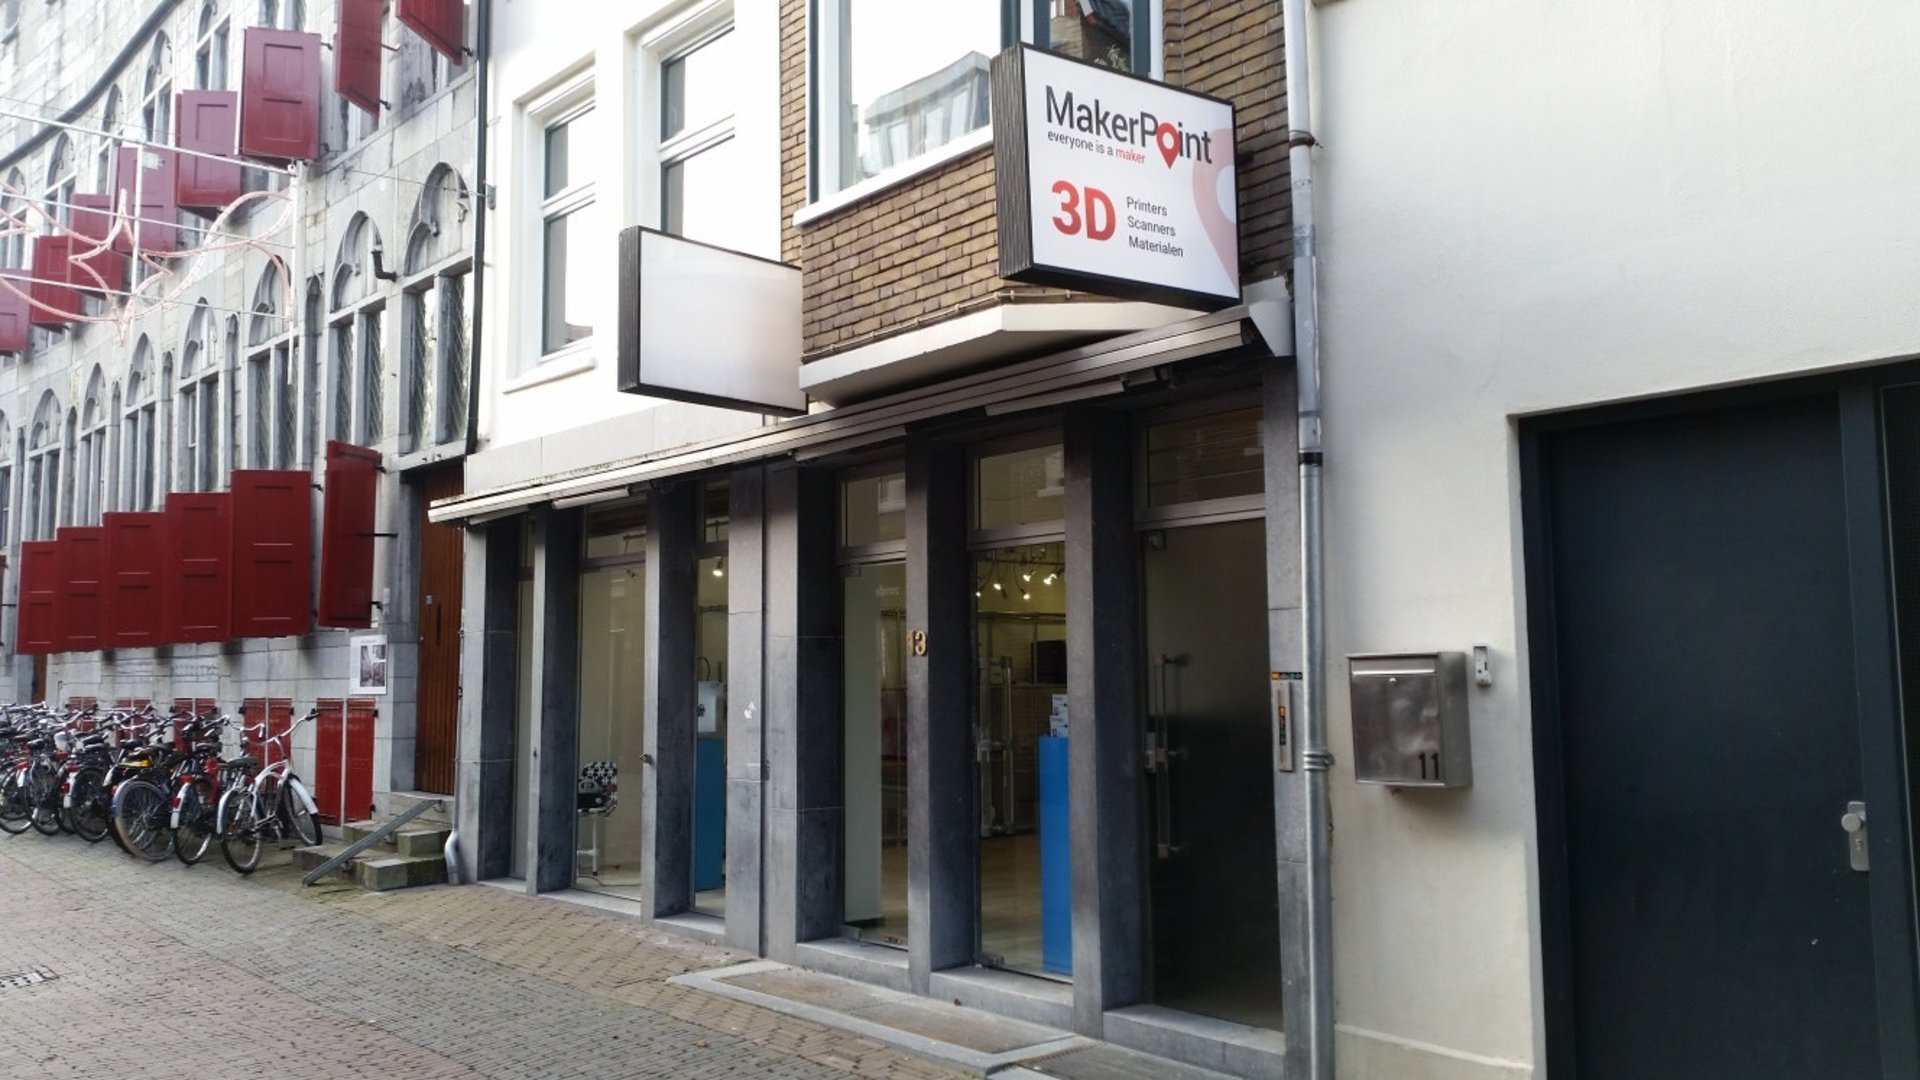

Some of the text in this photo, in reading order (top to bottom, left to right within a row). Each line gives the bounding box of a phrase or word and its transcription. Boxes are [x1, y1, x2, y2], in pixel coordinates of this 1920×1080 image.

[1046, 85, 1213, 169] MakerPoint
[1047, 130, 1146, 164] everyone is a maker
[1052, 180, 1116, 241] 3D
[1126, 196, 1168, 216] Printers
[1127, 215, 1176, 237] Scanners
[1128, 235, 1184, 258] Materialen
[908, 630, 927, 656] 13
[1418, 751, 1439, 779] 11
